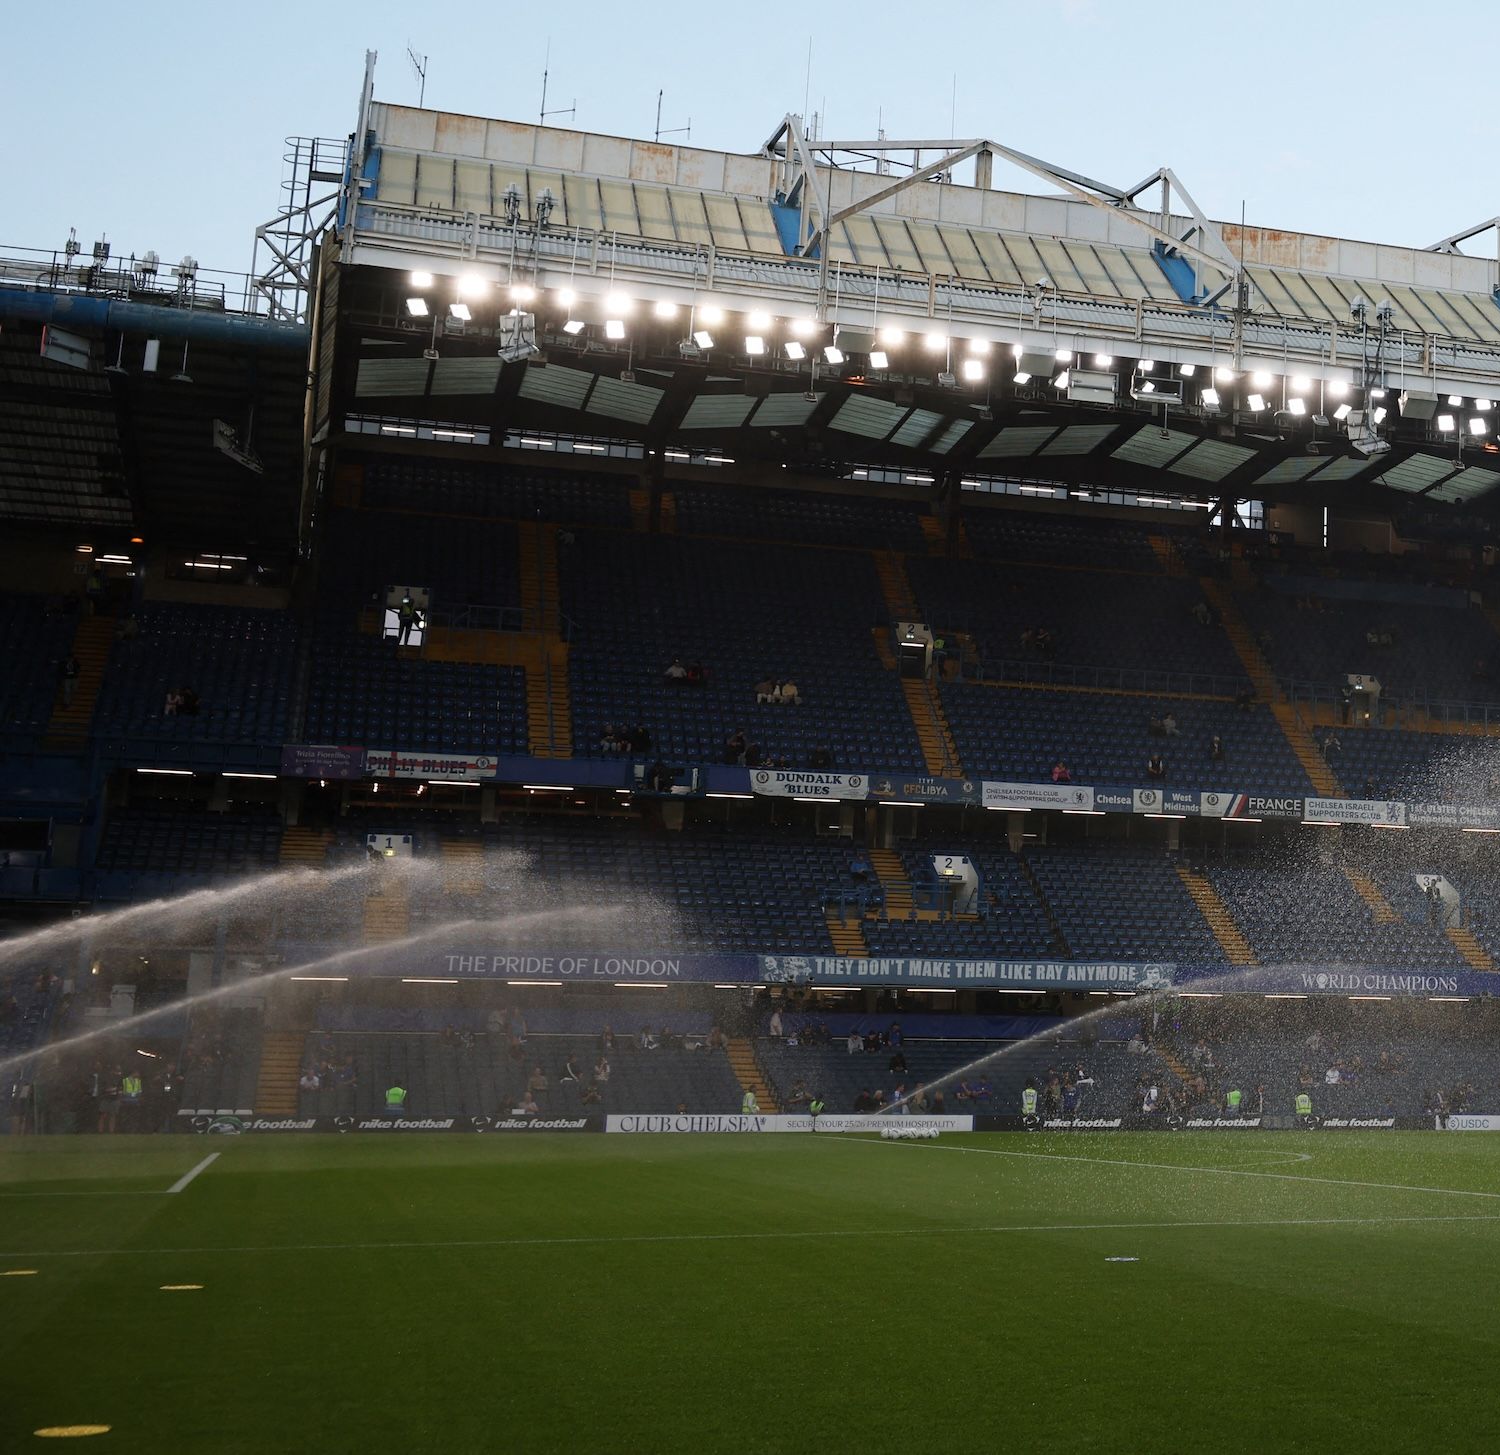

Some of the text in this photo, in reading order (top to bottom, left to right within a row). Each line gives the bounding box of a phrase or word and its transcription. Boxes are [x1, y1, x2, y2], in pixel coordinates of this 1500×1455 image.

[907, 623, 915, 634] 2
[1356, 675, 1362, 685] 3
[367, 756, 417, 772] PHILLY
[421, 760, 467, 774] BLUES
[776, 772, 842, 785] DUNDALK
[785, 783, 830, 795] BLUES
[1096, 794, 1132, 805] Chelsea
[1172, 792, 1192, 803] West
[1164, 802, 1200, 812] Midlands
[1248, 797, 1301, 811] FRANCE
[1308, 801, 1375, 811] CHELSEA ISRAELI
[1248, 809, 1284, 817] SUPPORTERS
[1308, 809, 1381, 820] SUPPORTERS CLUB
[1427, 804, 1457, 815] ULSTER
[1459, 806, 1498, 817] CHELSEA
[385, 837, 393, 849] 1
[945, 857, 953, 869] 2
[1423, 876, 1430, 887] 3
[446, 955, 680, 976] THE PRIDE OF LONDON
[815, 958, 1136, 982] THEY DON'T MAKE THEM LIKE RAY ANYMORE
[1301, 973, 1458, 992] WORLD CHAMPIONS
[252, 1118, 317, 1129] football
[358, 1118, 455, 1129] nike football
[495, 1118, 588, 1129] nike football
[620, 1116, 762, 1132] CLUB CHELSEA
[787, 1119, 819, 1128] SECURE
[820, 1119, 843, 1129] YOUR
[866, 1119, 904, 1129] PREMIUM
[905, 1119, 956, 1129] HOSPITALITY
[1043, 1118, 1122, 1128] nike football
[1186, 1118, 1261, 1128] nike football
[1322, 1118, 1395, 1128] nike football
[1460, 1119, 1489, 1129] USDC
